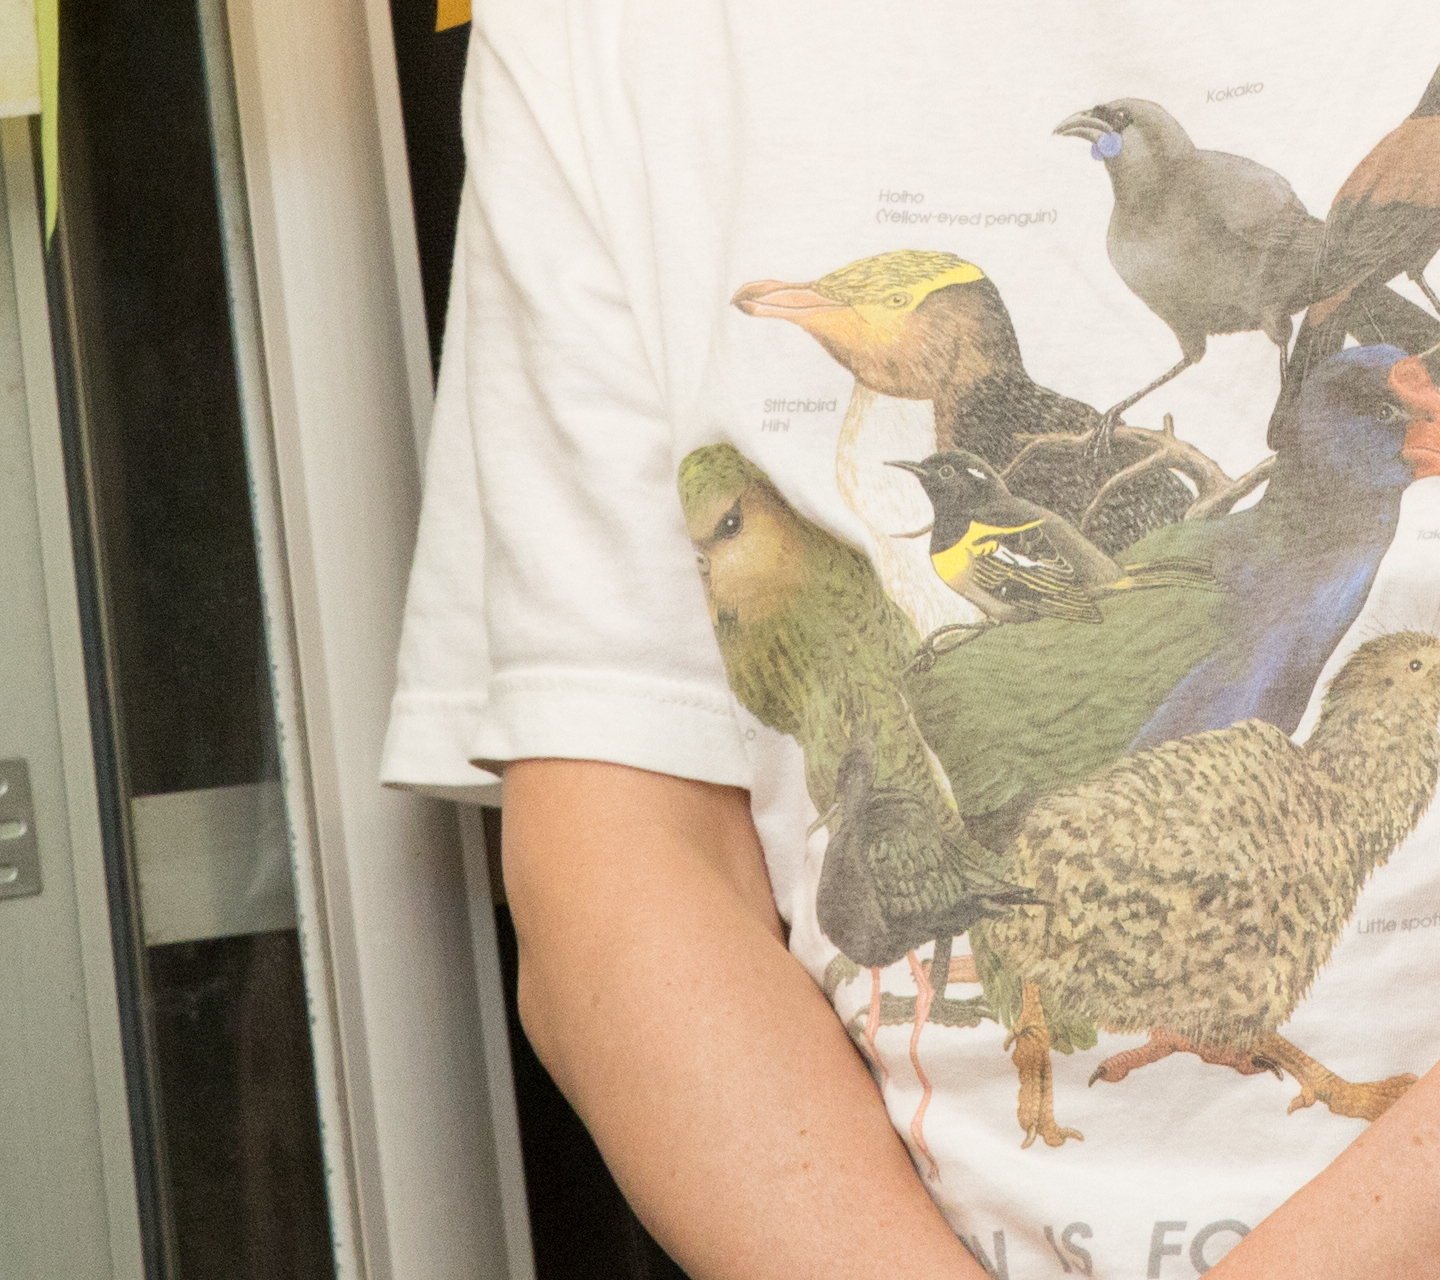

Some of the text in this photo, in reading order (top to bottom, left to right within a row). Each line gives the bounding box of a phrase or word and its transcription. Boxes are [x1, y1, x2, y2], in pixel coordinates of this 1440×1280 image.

[1206, 80, 1265, 104] Kokako
[877, 188, 925, 204] Hoiho
[875, 207, 1058, 228] (Yellow-eyed penguin)
[763, 397, 837, 413] Stitchbird
[761, 418, 790, 433] Hihi
[1357, 918, 1397, 935] Little
